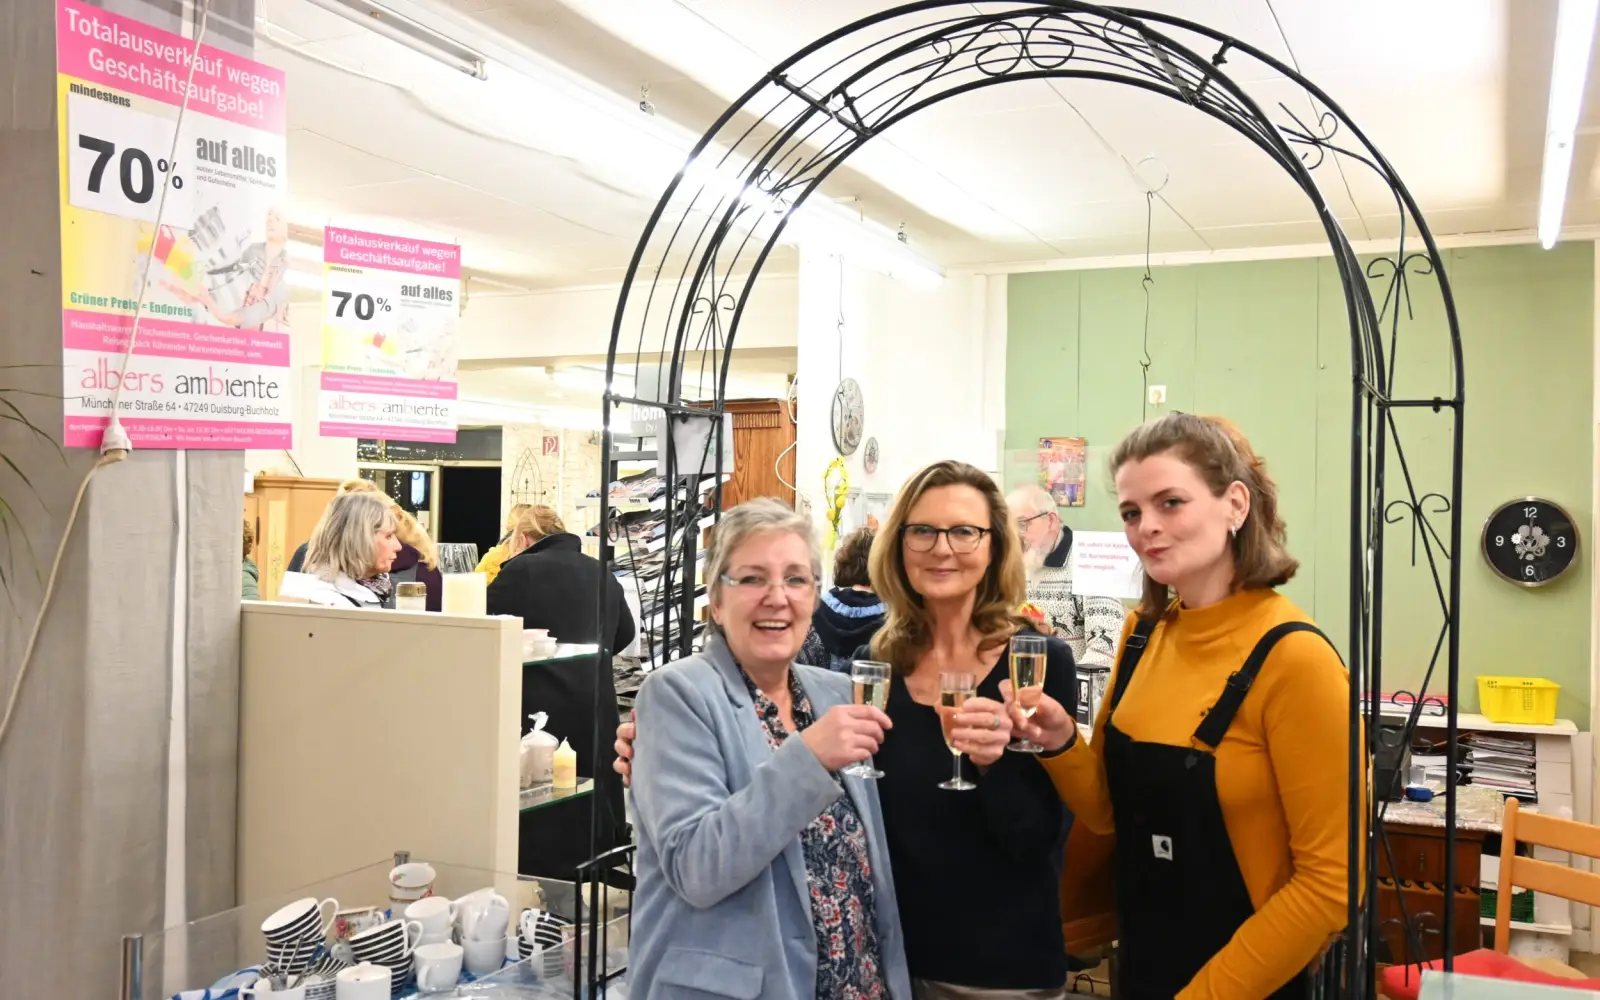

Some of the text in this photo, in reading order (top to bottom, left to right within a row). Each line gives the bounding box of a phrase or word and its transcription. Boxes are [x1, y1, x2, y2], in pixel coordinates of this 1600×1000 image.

[64, 6, 280, 98] Totalausverkauf wegen
[70, 82, 131, 108] mindestens
[88, 47, 264, 119] Geschäftsaufgabe!
[196, 137, 277, 178] auf alles
[329, 230, 457, 260] Totalausverkauf wegen
[340, 248, 446, 273] Geschäftsaufgabe!
[70, 291, 109, 307] Grüner
[110, 296, 138, 310] Preis
[149, 302, 193, 317] Endpreis
[400, 284, 453, 302] auf alles
[81, 357, 280, 399] albers ambiente
[81, 396, 279, 416] Münchner Straße 64 47249 Duisburg-Buchholz
[328, 394, 449, 418] albers ambiente
[1523, 507, 1538, 518] 12
[1495, 536, 1504, 547] 9
[1556, 536, 1566, 548] 3
[1525, 565, 1534, 576] 6
